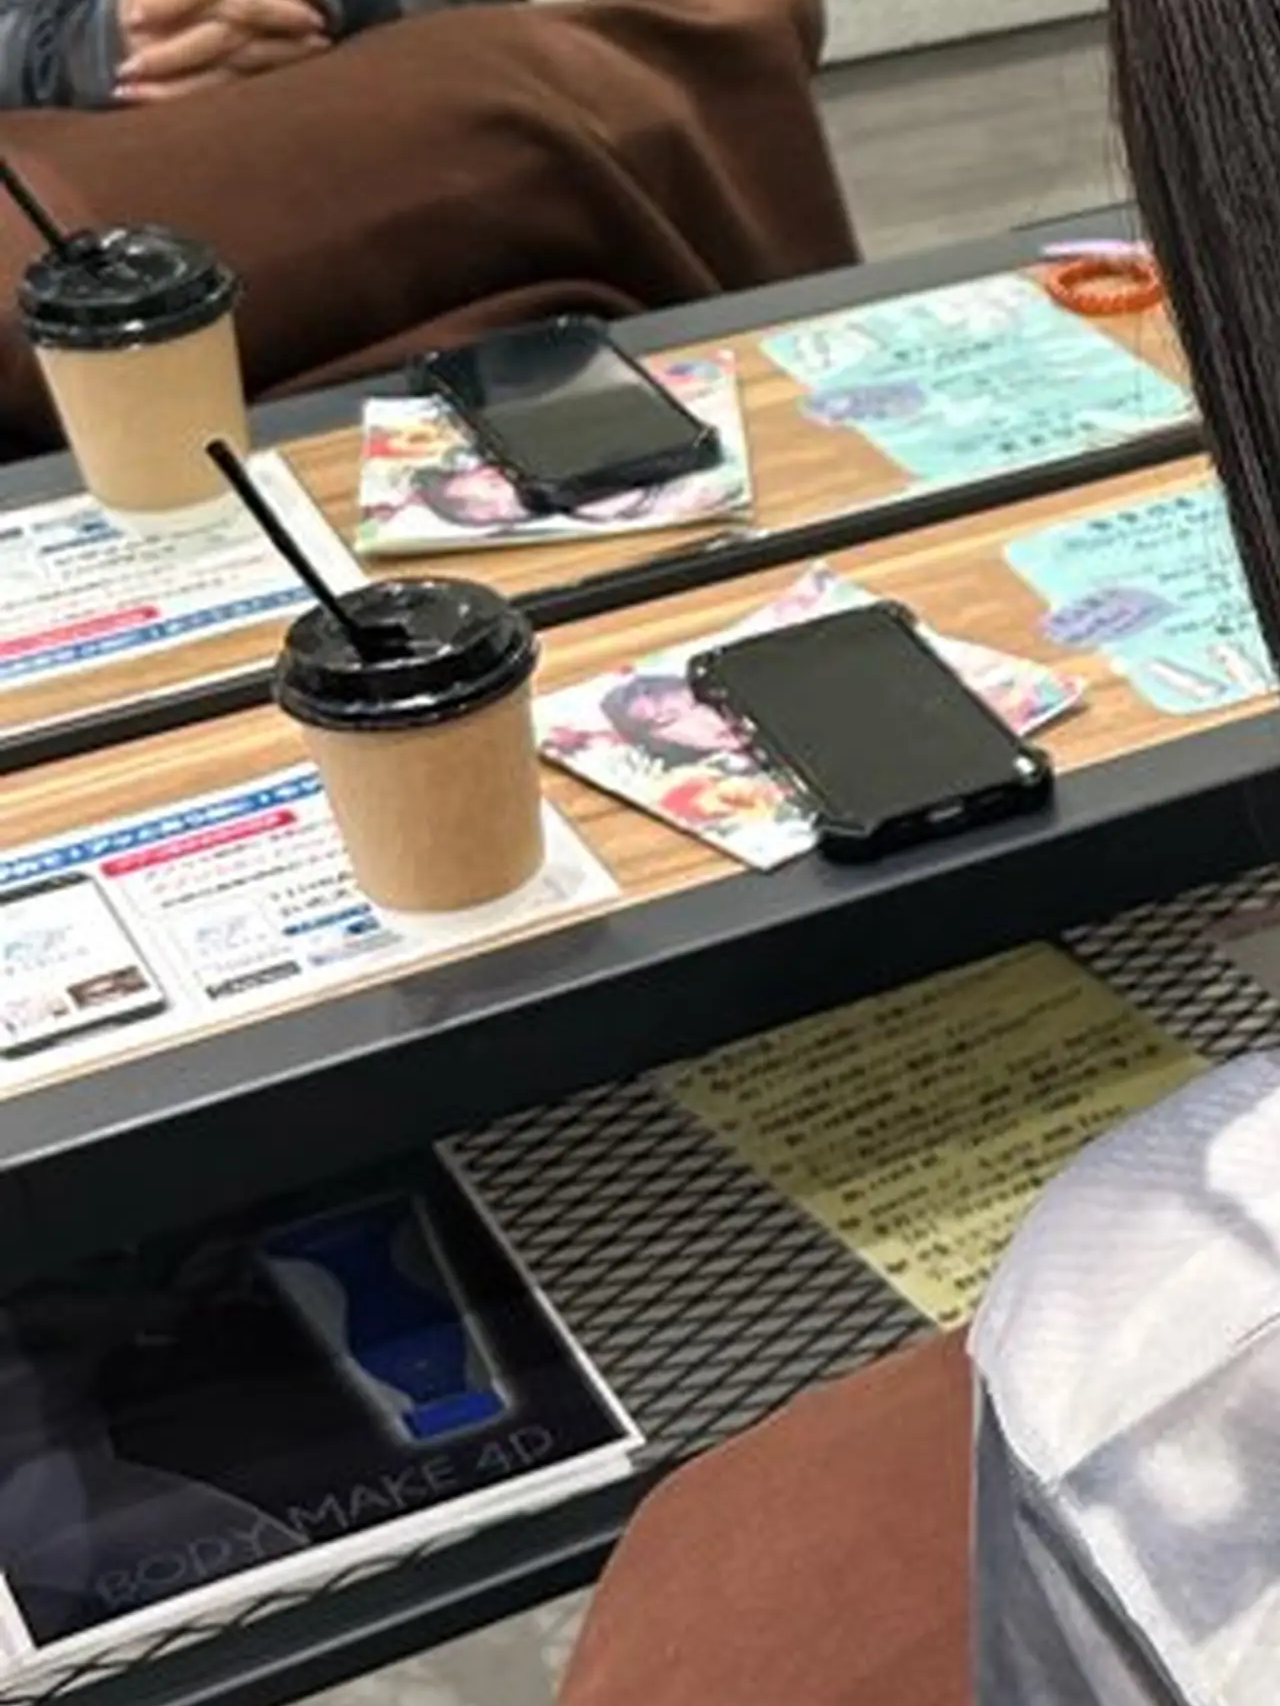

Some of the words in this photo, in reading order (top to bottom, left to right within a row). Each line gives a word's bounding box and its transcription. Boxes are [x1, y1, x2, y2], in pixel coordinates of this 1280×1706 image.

[97, 1519, 270, 1601] BODY
[288, 1459, 458, 1531] MAKE
[476, 1425, 552, 1475] 4D
